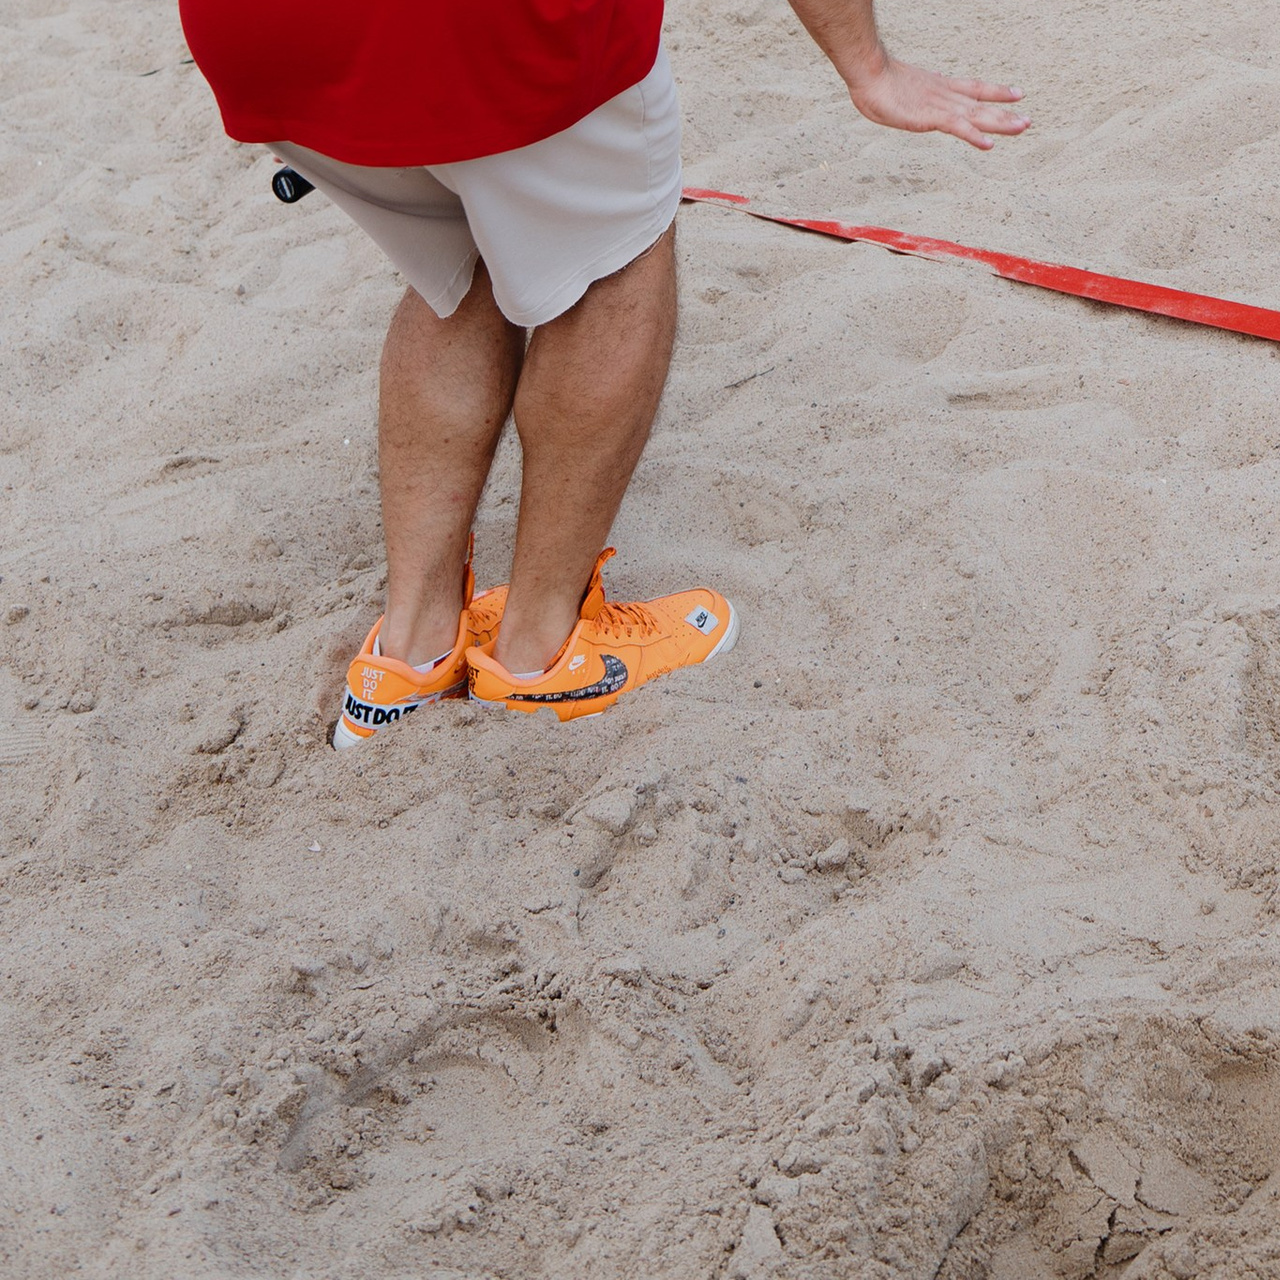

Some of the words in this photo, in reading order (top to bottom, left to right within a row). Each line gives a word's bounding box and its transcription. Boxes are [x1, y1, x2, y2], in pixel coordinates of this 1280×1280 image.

[361, 666, 386, 682] JUST
[363, 679, 378, 691] DO
[362, 689, 374, 701] IT.
[345, 694, 373, 724] JUST
